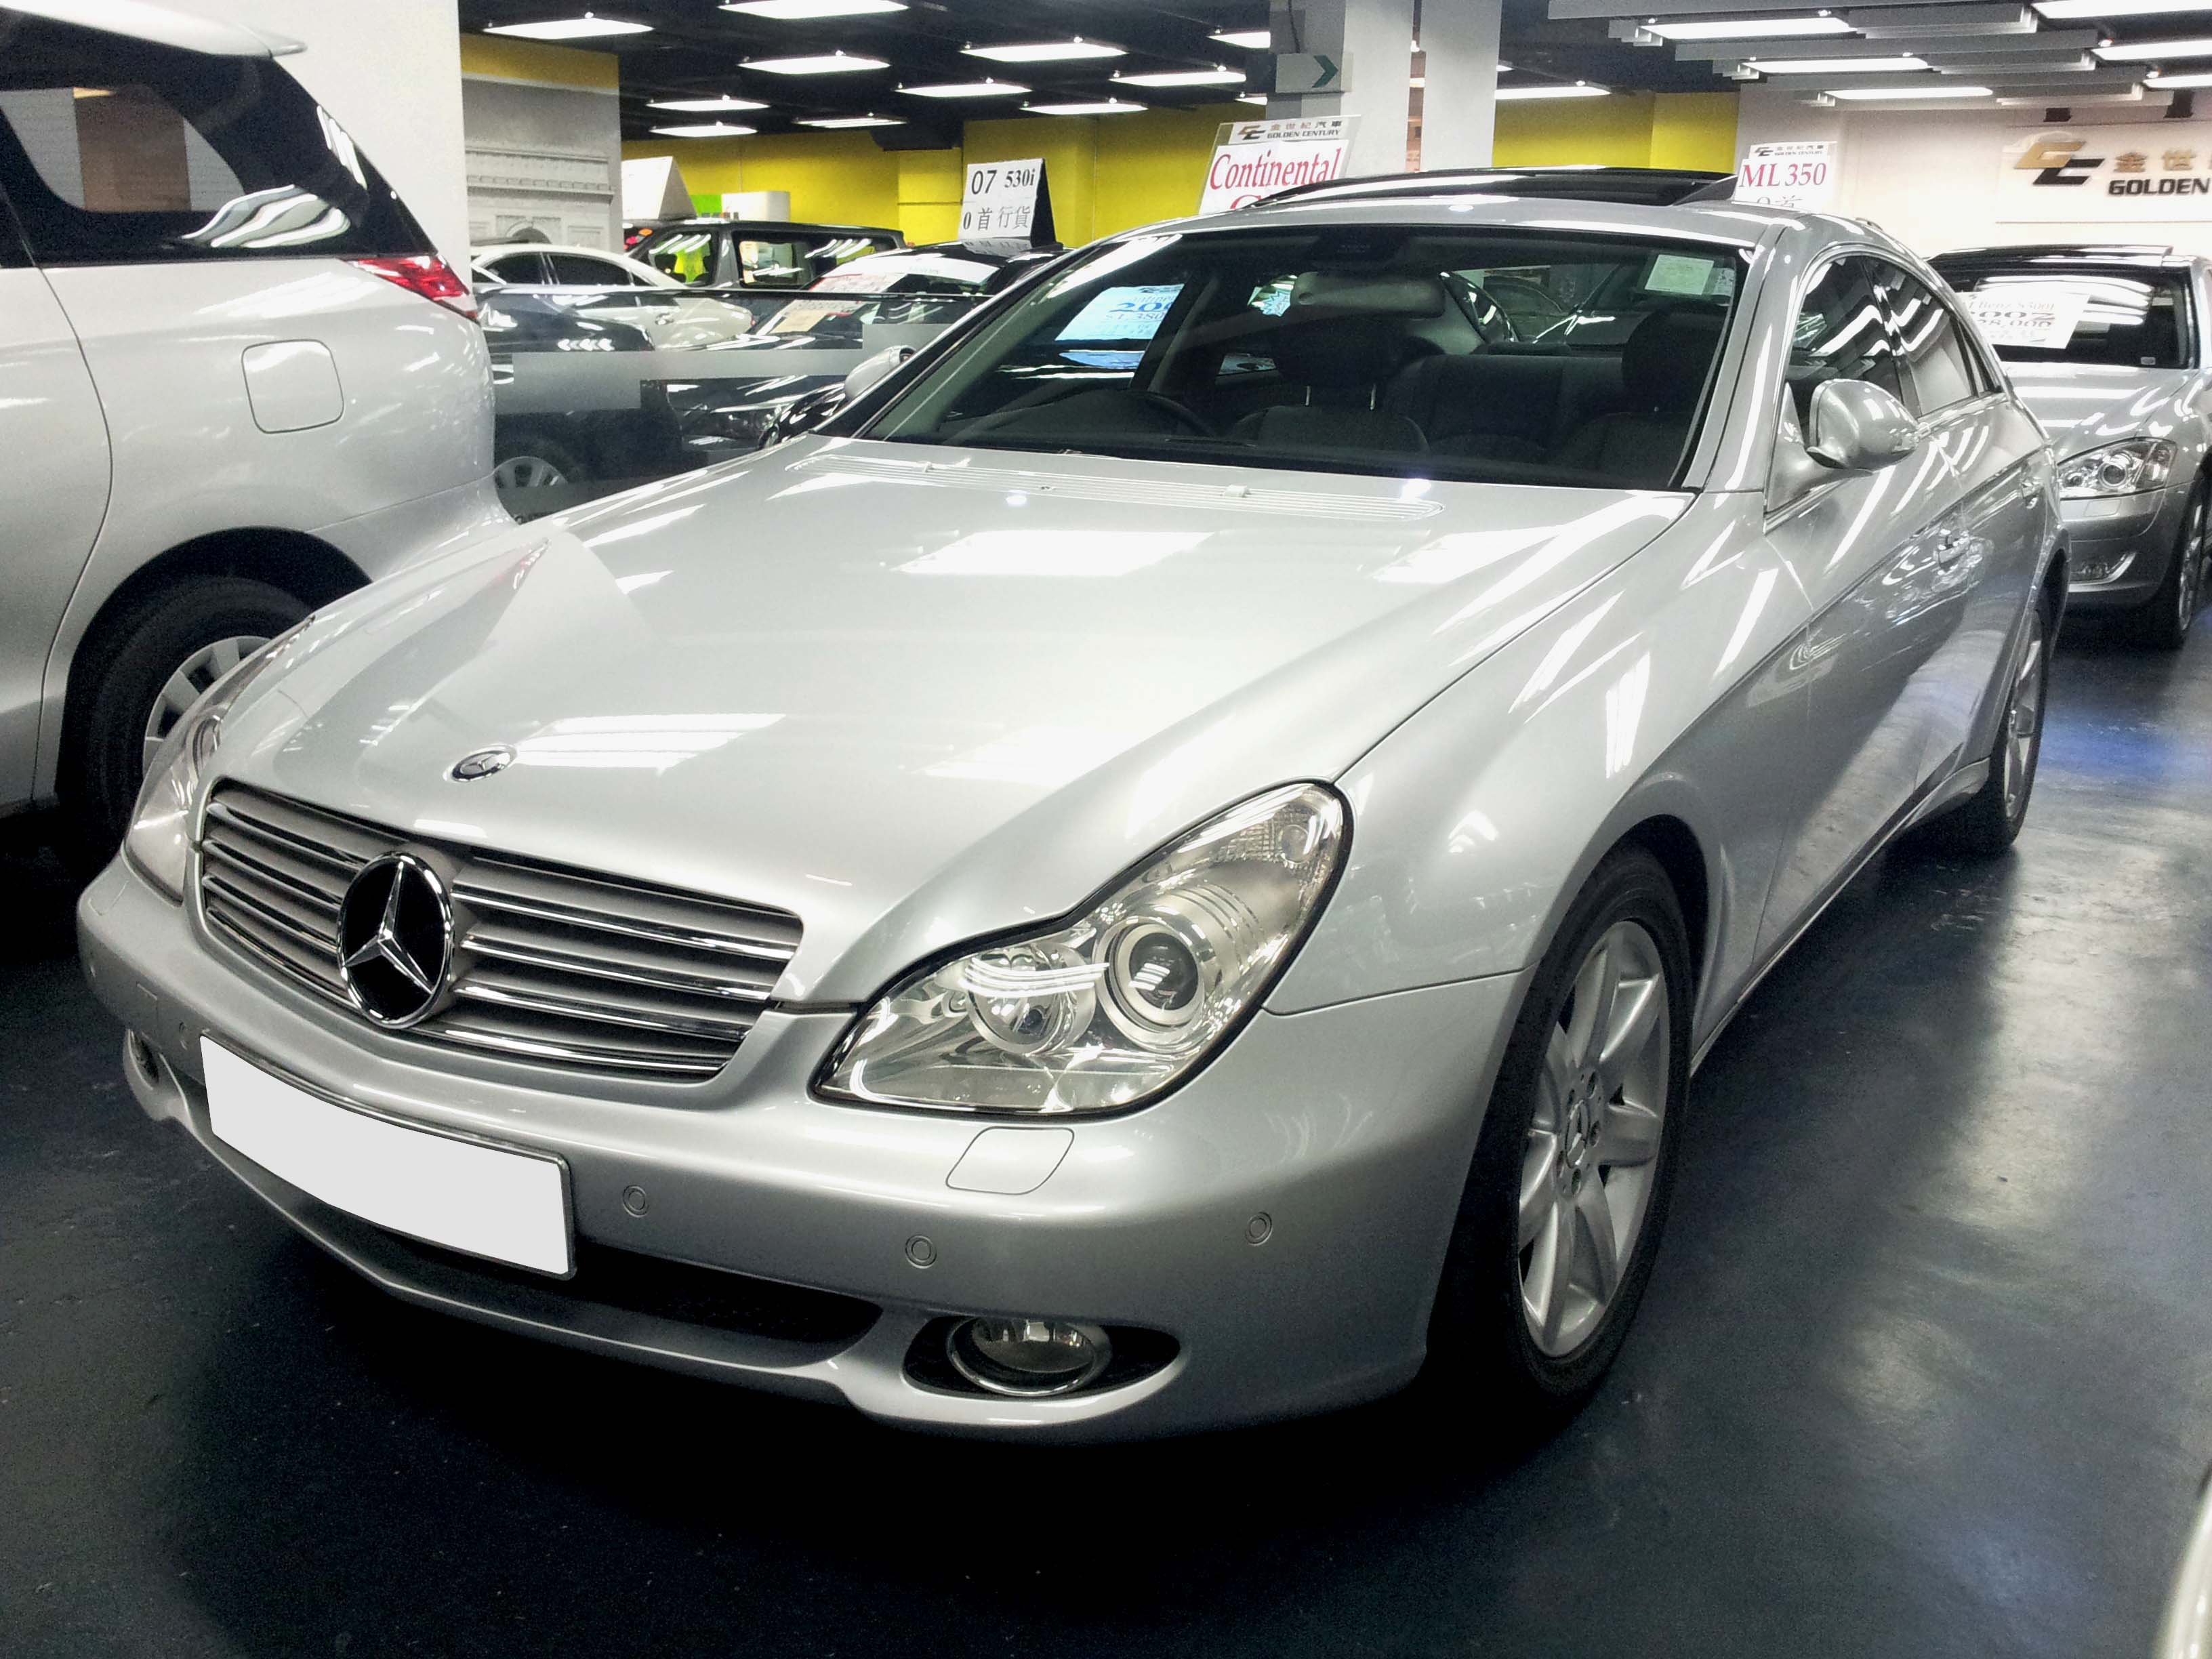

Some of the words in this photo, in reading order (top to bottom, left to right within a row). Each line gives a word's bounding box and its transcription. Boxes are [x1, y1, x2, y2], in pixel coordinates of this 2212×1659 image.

[1267, 131, 1300, 139] GOLDEN
[1302, 129, 1340, 138] CENTURY
[970, 169, 998, 194] 07
[1004, 168, 1036, 188] 530i
[1210, 147, 1343, 190] Continental
[1738, 163, 1780, 188] ML
[1784, 162, 1827, 186] 350
[2108, 178, 2211, 196] GOLDEN
